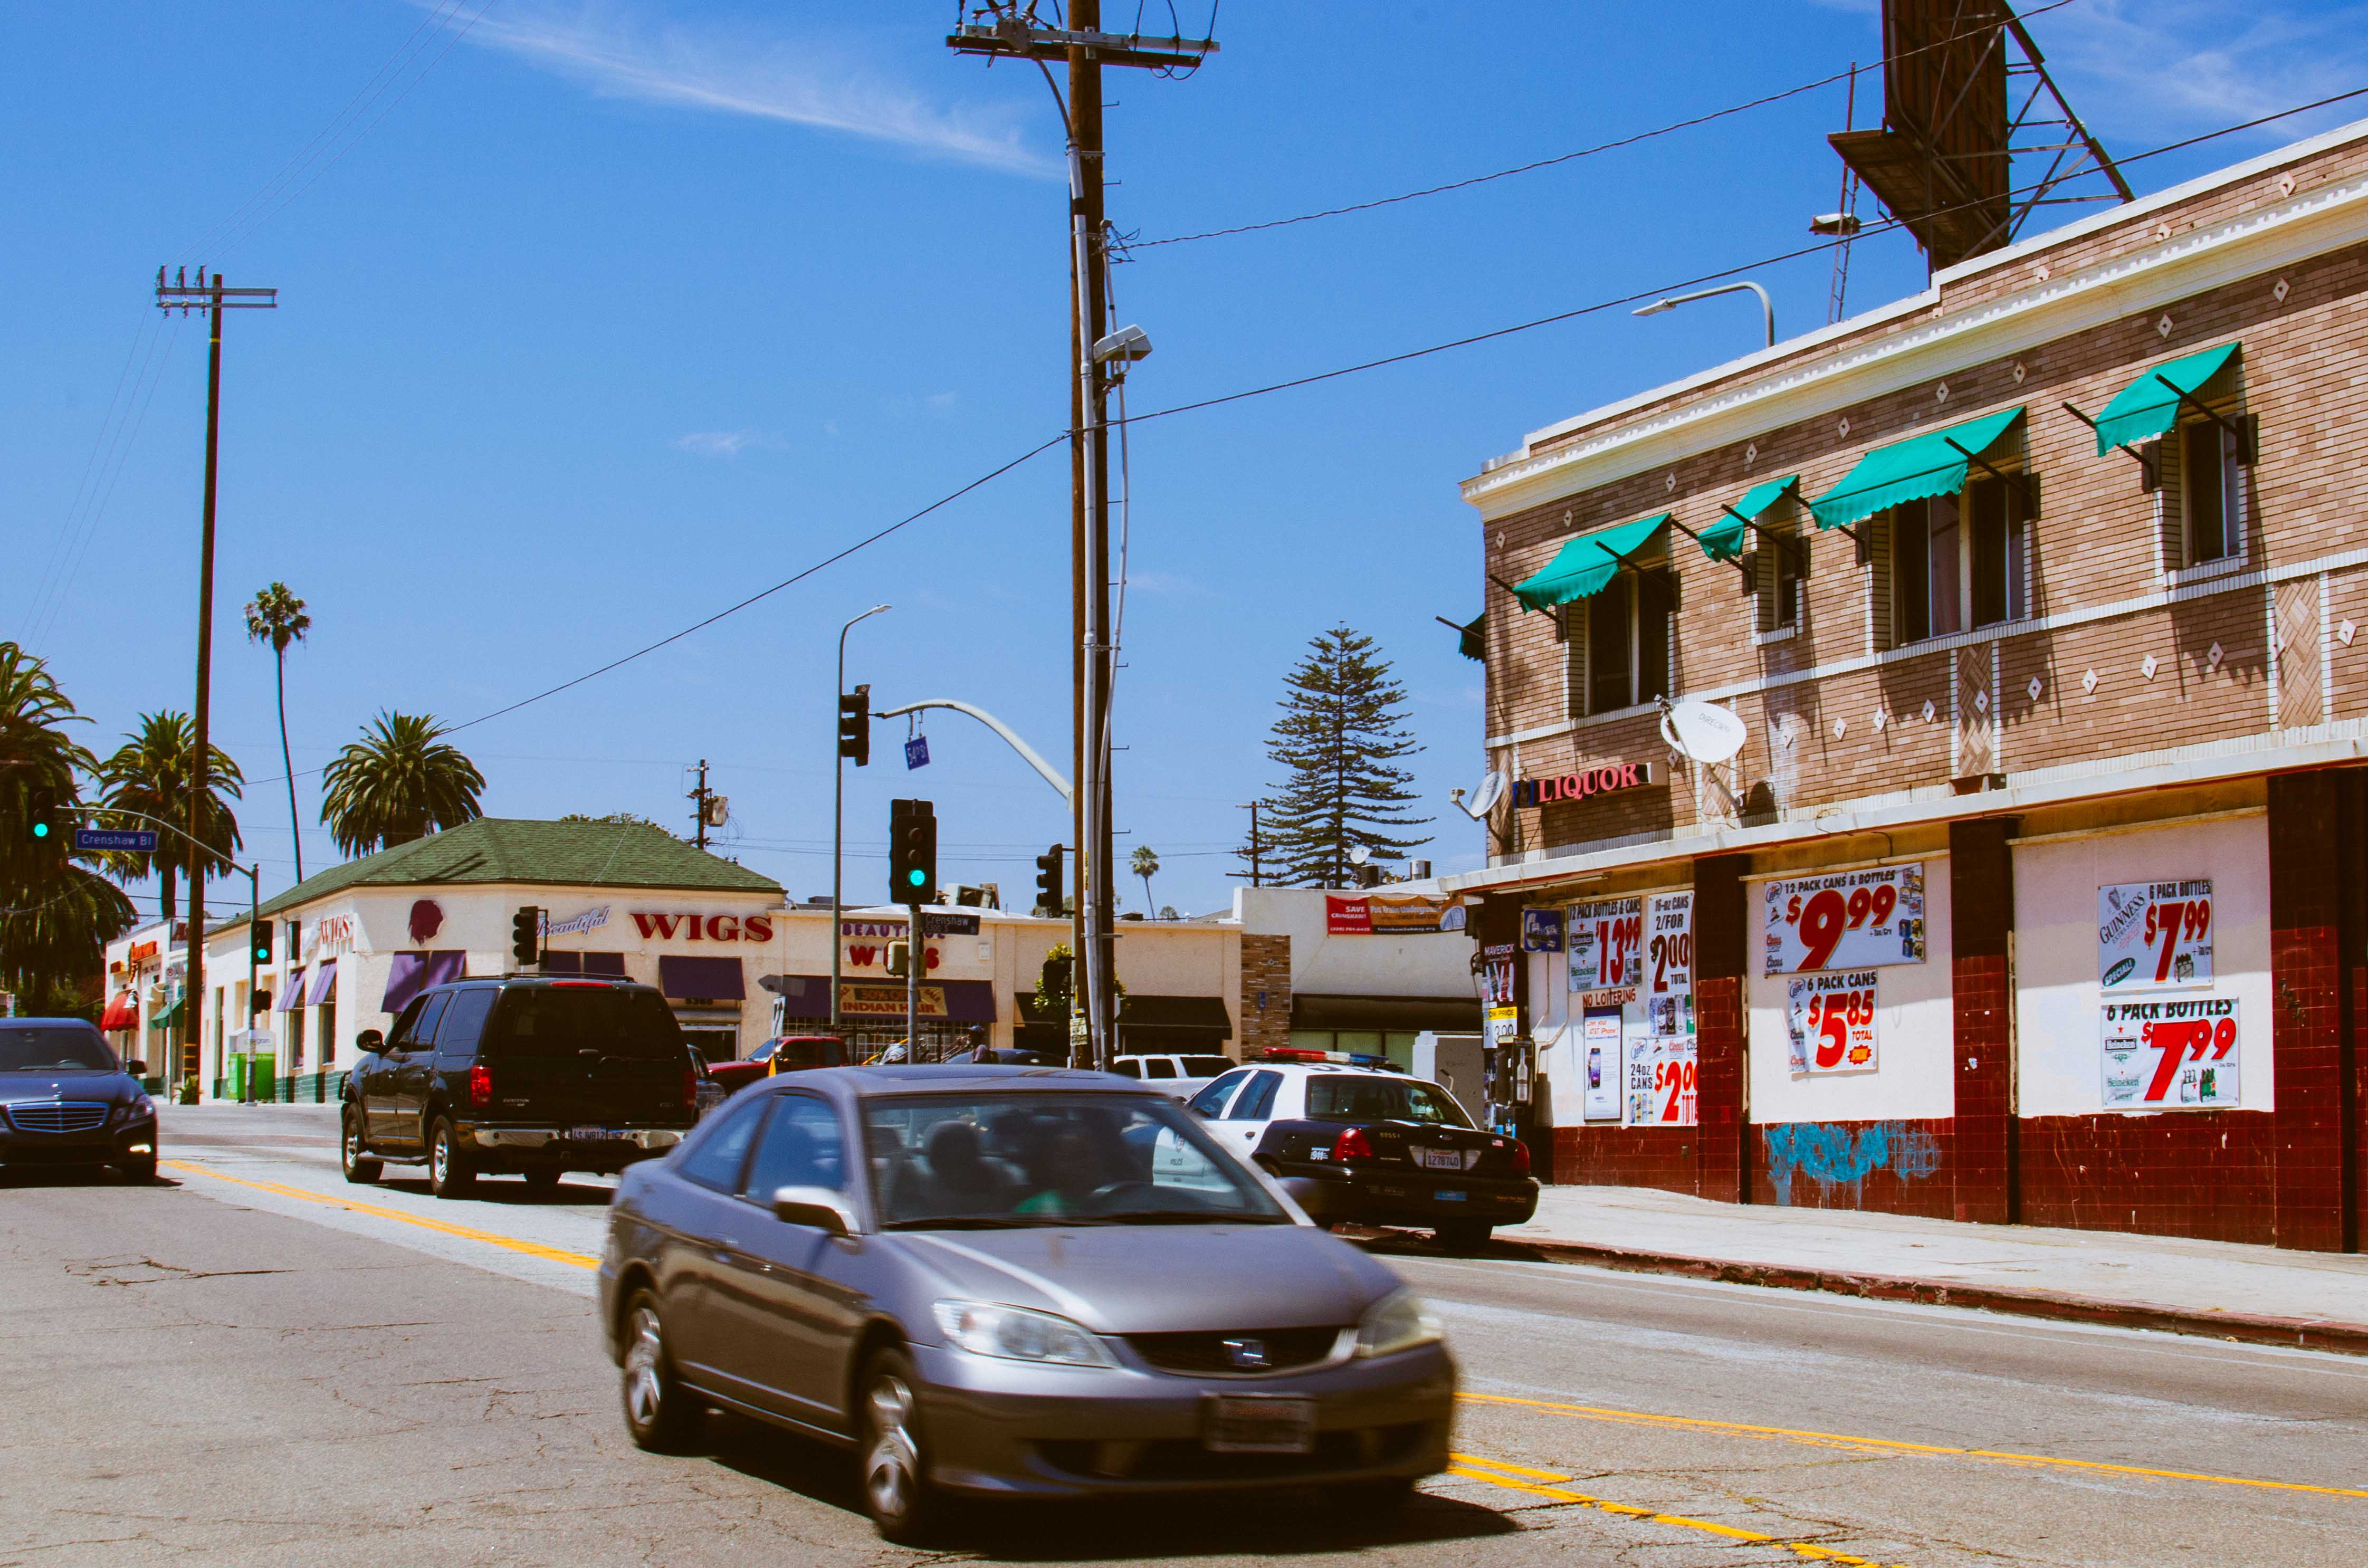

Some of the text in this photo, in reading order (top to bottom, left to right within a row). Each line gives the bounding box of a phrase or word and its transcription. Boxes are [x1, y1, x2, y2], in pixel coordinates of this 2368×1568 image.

[1539, 763, 1639, 802] LIQUOR
[82, 834, 151, 845] Crenshaw Bl
[1785, 870, 1895, 894] 12 PACK CANS & BOTTLES
[2150, 880, 2211, 899] 6 PACK BOTTLES
[1577, 905, 1592, 919] PACK
[1593, 900, 1618, 917] BOTTLES
[1619, 900, 1624, 914] &
[1626, 898, 1640, 913] CANS
[1672, 895, 1689, 909] CANS
[536, 906, 612, 938] Beautiful
[925, 914, 969, 926] Crenshaw
[1656, 913, 1684, 930] 2/FOR
[2099, 891, 2145, 944] GUINNESS
[320, 914, 350, 944] WIGS
[629, 913, 774, 942] WIGS
[1485, 943, 1514, 956] MAVERICK
[1571, 966, 1597, 976] Heineken
[1670, 973, 1687, 984] TOTAL
[1807, 971, 1877, 991] 6 PACK CANS
[1582, 988, 1636, 1007] NO LOITERING
[843, 1002, 935, 1013] INDIAN HIR
[1498, 1008, 1514, 1017] PRICE
[2107, 999, 2232, 1021] 6 PACK BOTTLES
[1852, 1029, 1873, 1041] TOTAL
[1631, 1077, 1653, 1090] CANS
[2107, 1077, 2140, 1087] Heineken
